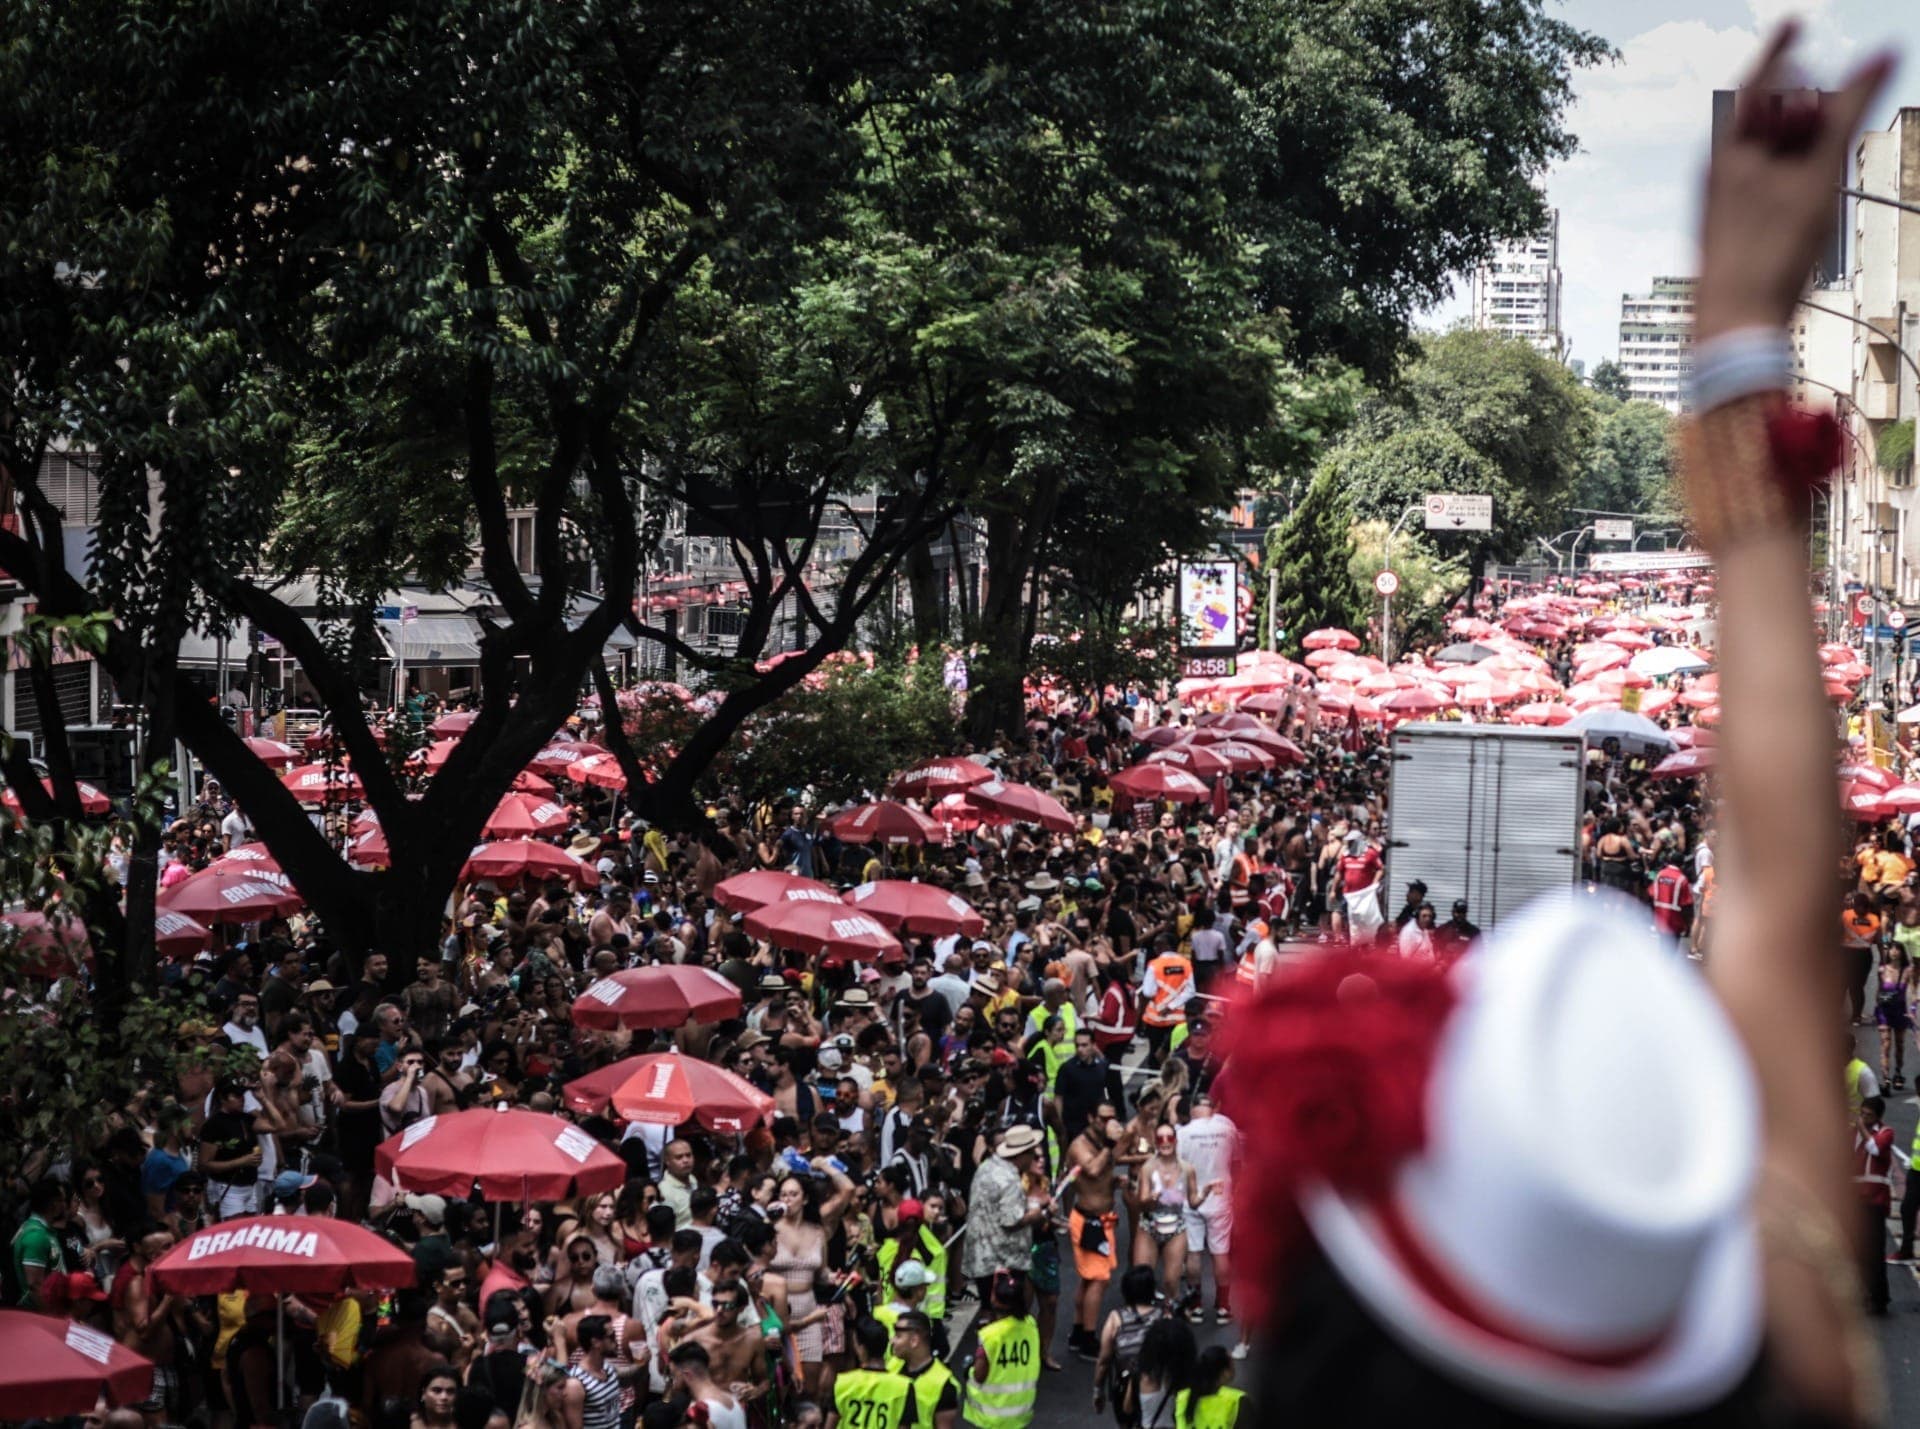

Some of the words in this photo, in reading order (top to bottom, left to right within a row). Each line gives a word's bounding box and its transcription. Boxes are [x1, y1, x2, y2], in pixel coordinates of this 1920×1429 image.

[1380, 577, 1395, 587] 50
[1861, 600, 1874, 610] 50
[1185, 659, 1226, 675] 13:58
[187, 1224, 319, 1261] BRAHMA
[996, 1339, 1031, 1369] 440
[848, 1399, 889, 1429] 276
